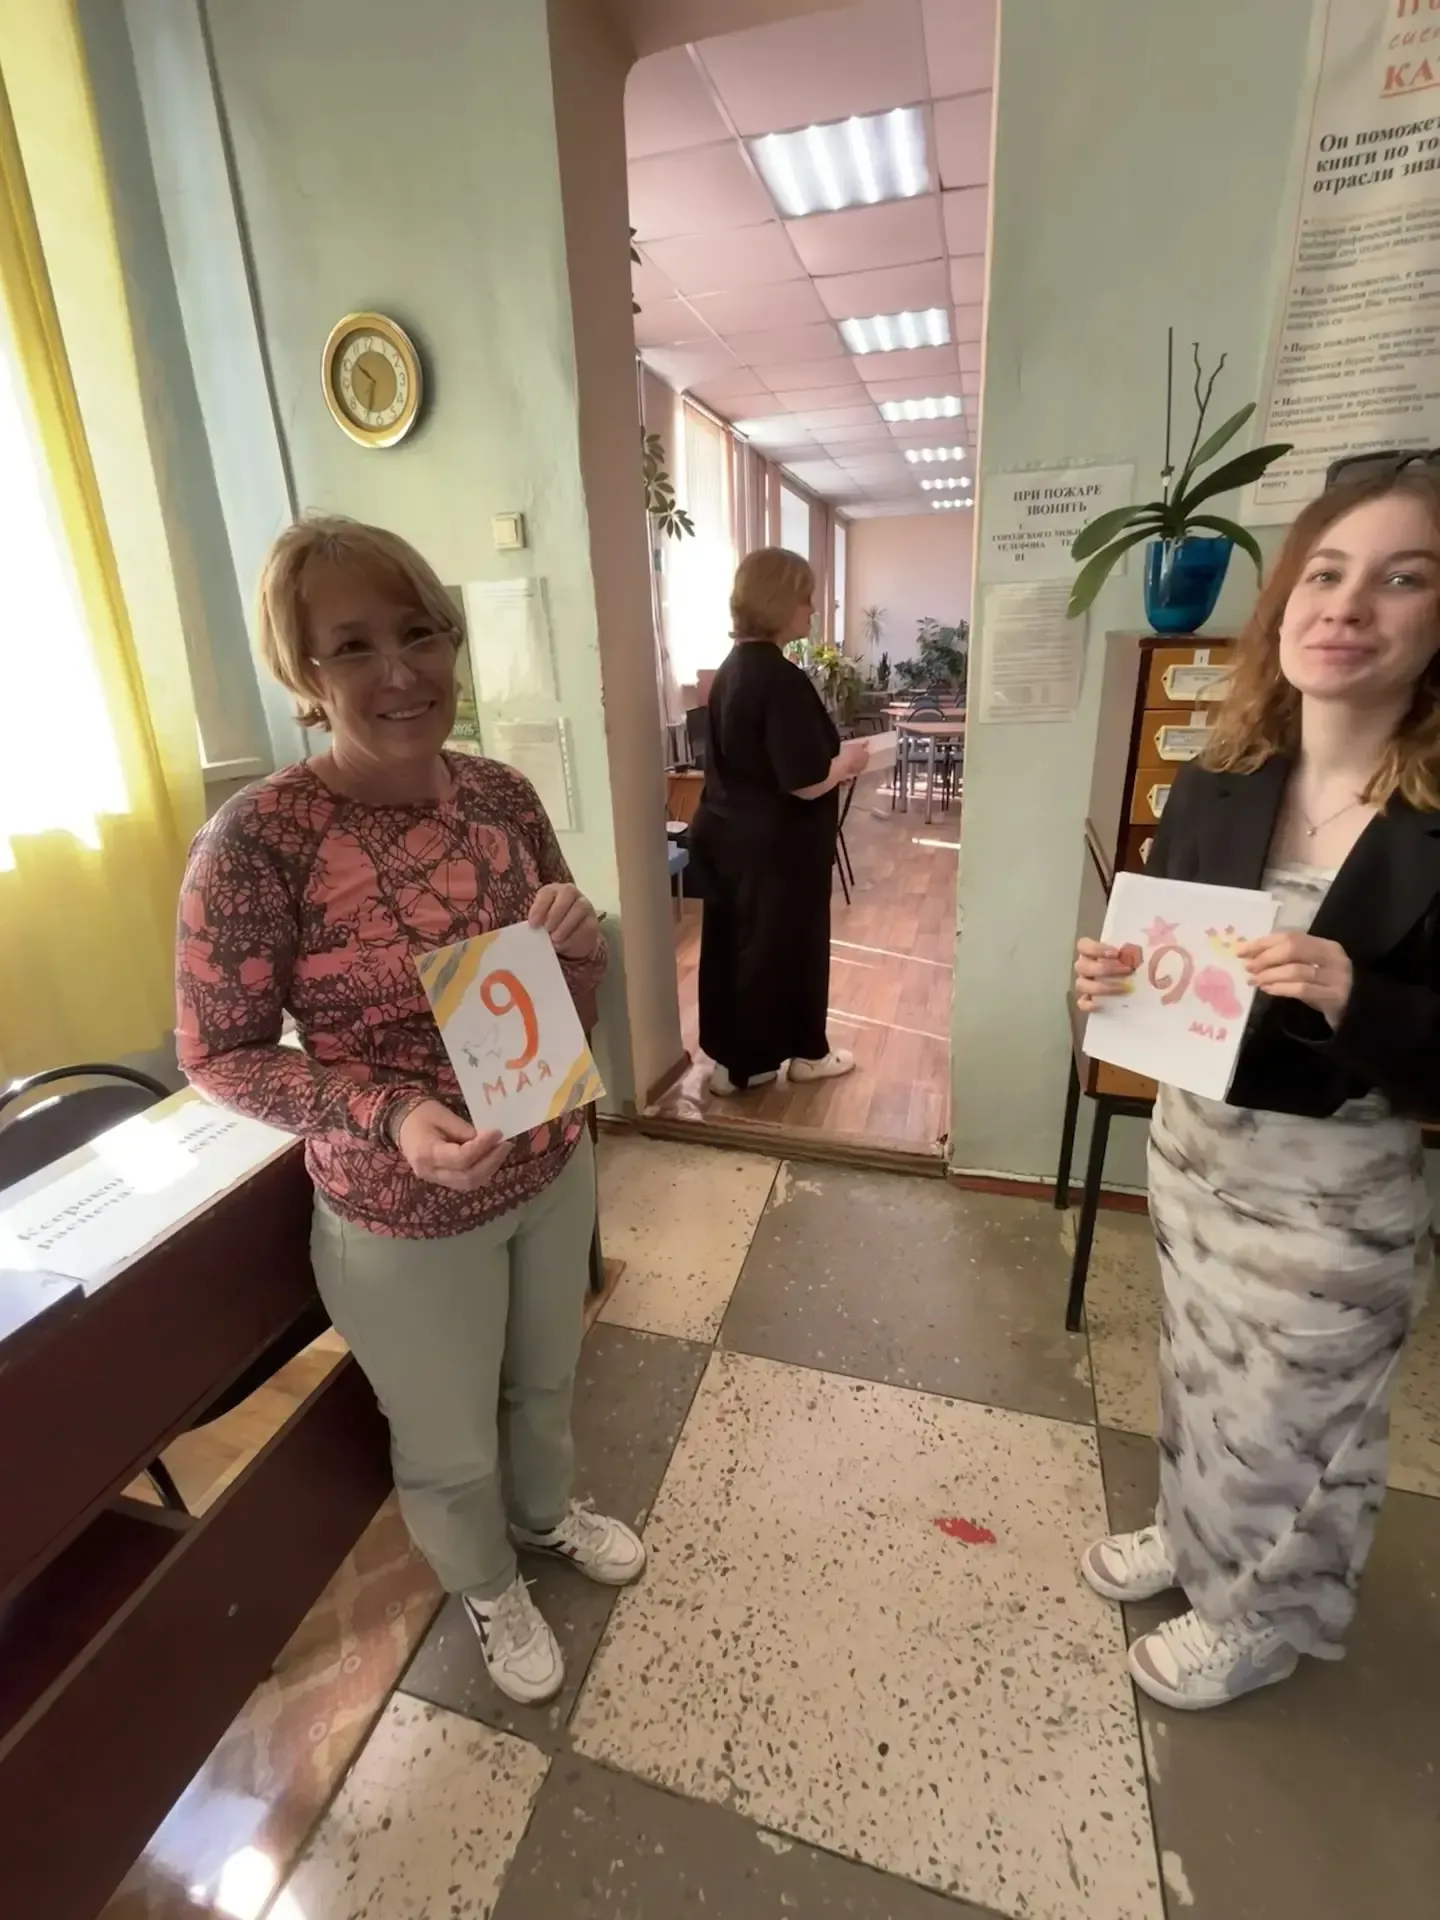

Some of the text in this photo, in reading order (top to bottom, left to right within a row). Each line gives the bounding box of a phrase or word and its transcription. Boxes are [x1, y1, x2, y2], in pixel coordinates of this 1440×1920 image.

[1383, 57, 1440, 91] КА
[1320, 134, 1349, 152] Он
[1316, 151, 1377, 173] книги
[1384, 144, 1409, 163] по
[1313, 167, 1393, 195] отрасли
[1013, 484, 1103, 502] ПРИ ПОЖАРЕ
[1027, 501, 1087, 516] ЗВОНИТЬ
[992, 530, 1052, 542] ГОРОДСКОГО
[1054, 527, 1081, 537] МОБИ
[998, 541, 1046, 551] ТЕЛЕФОНА
[1014, 552, 1026, 562] 01
[1147, 944, 1196, 1007] 9
[480, 969, 539, 1070] 9
[481, 1059, 553, 1107] МАЯ
